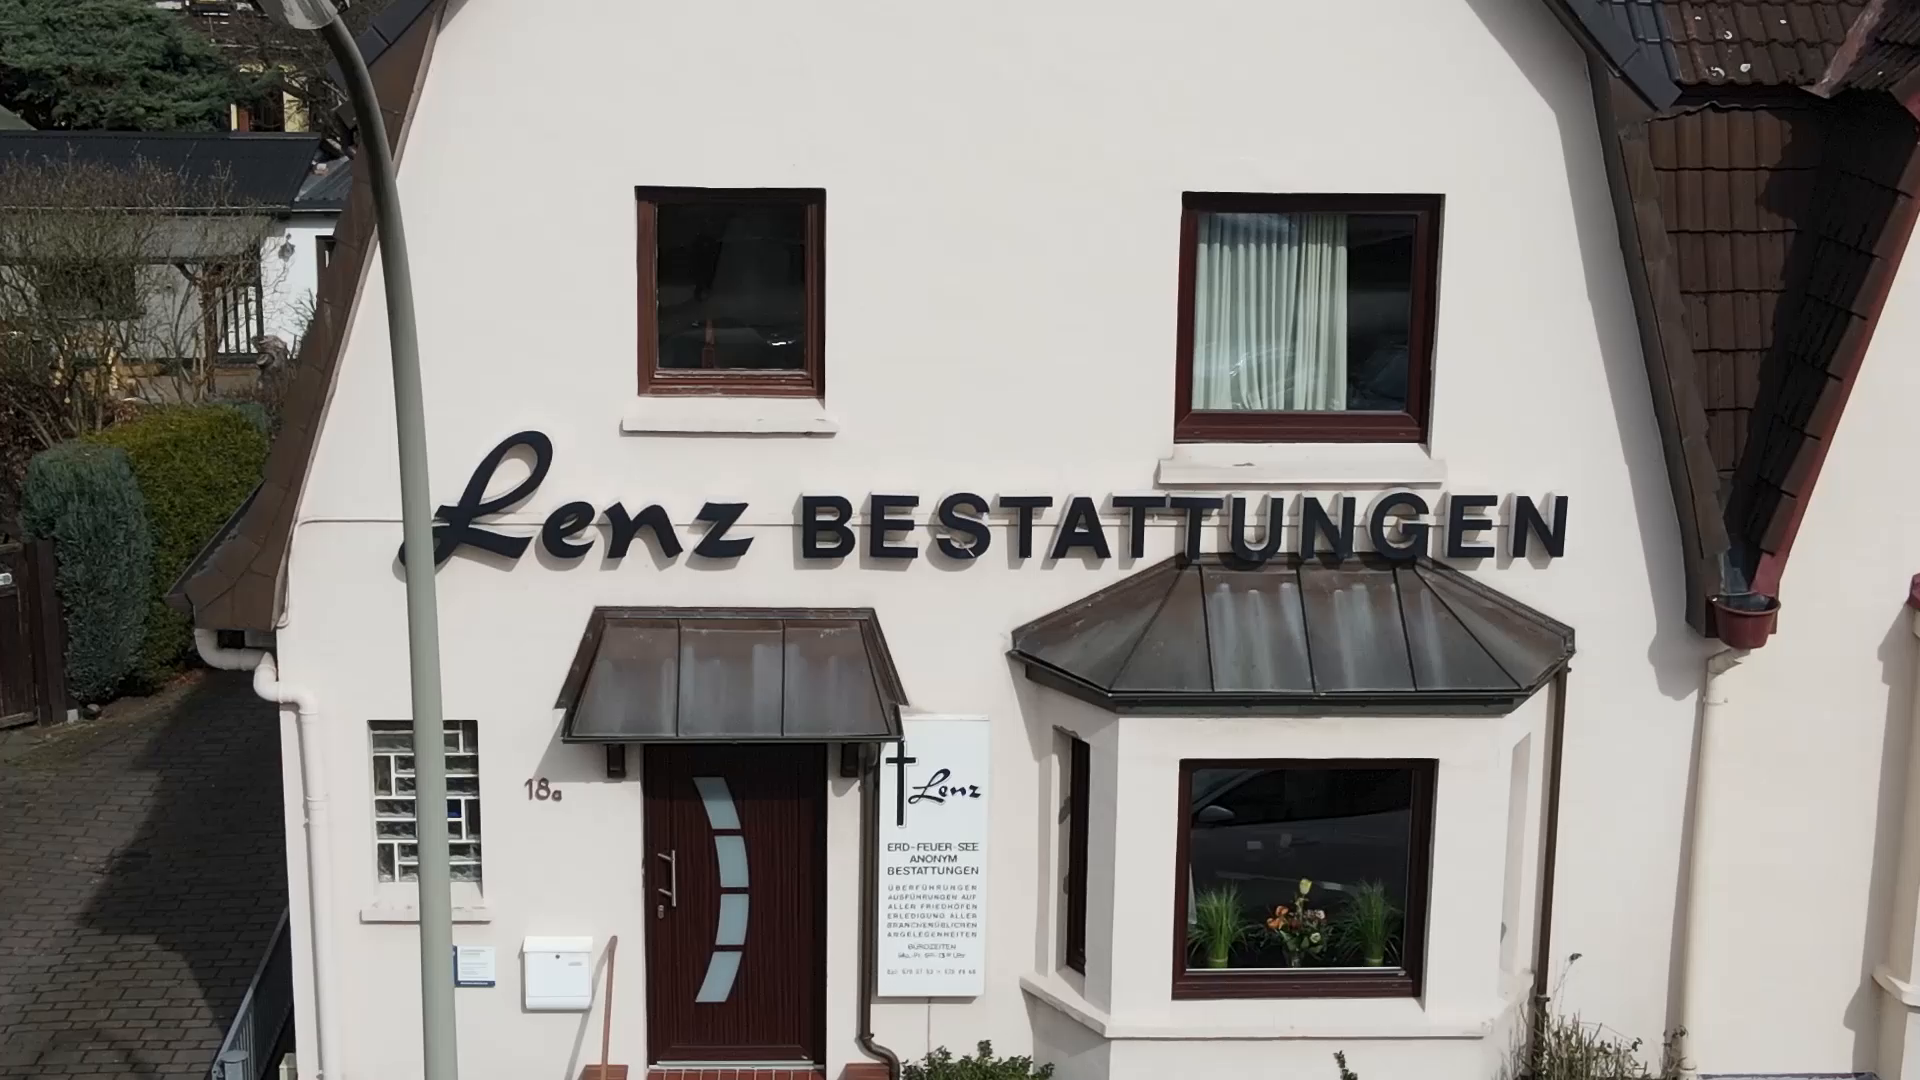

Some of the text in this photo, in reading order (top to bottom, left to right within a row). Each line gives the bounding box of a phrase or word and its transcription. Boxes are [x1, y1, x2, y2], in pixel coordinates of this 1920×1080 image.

[398, 430, 1568, 567] Lenz BESTATTUNGEN
[524, 777, 562, 802] 18a
[908, 768, 981, 804] Lenz
[887, 866, 979, 875] BESTATTUNGEN
[909, 854, 958, 863] ANONYM
